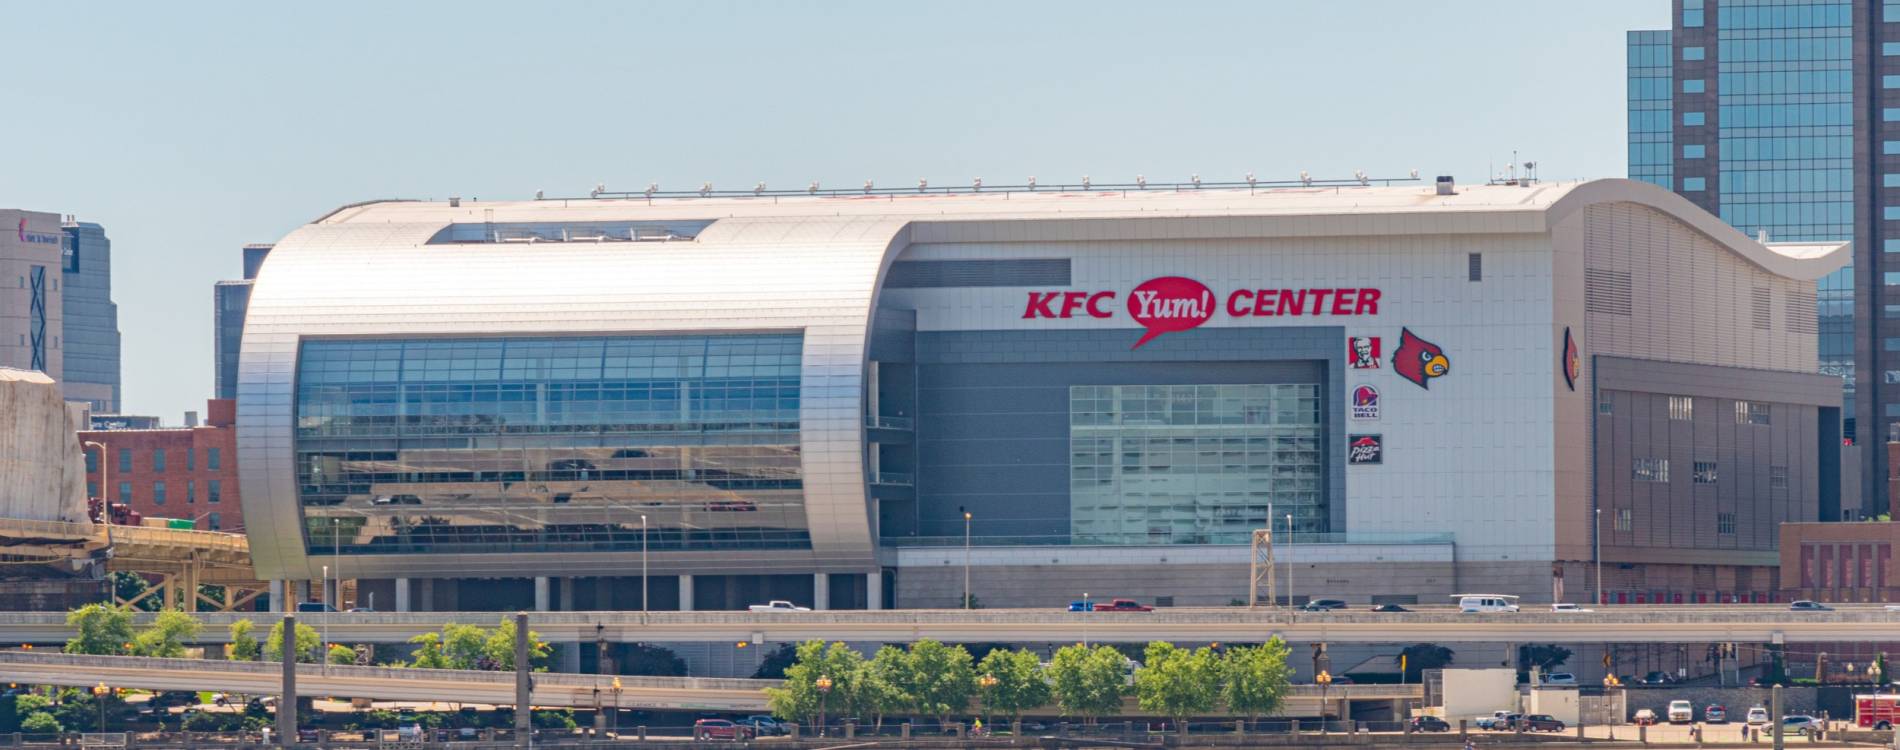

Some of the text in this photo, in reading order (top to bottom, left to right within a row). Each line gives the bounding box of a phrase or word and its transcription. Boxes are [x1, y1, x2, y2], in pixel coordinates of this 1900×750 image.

[1021, 288, 1382, 319] KFC Yum! CENTER
[1355, 452, 1376, 462] Hut
